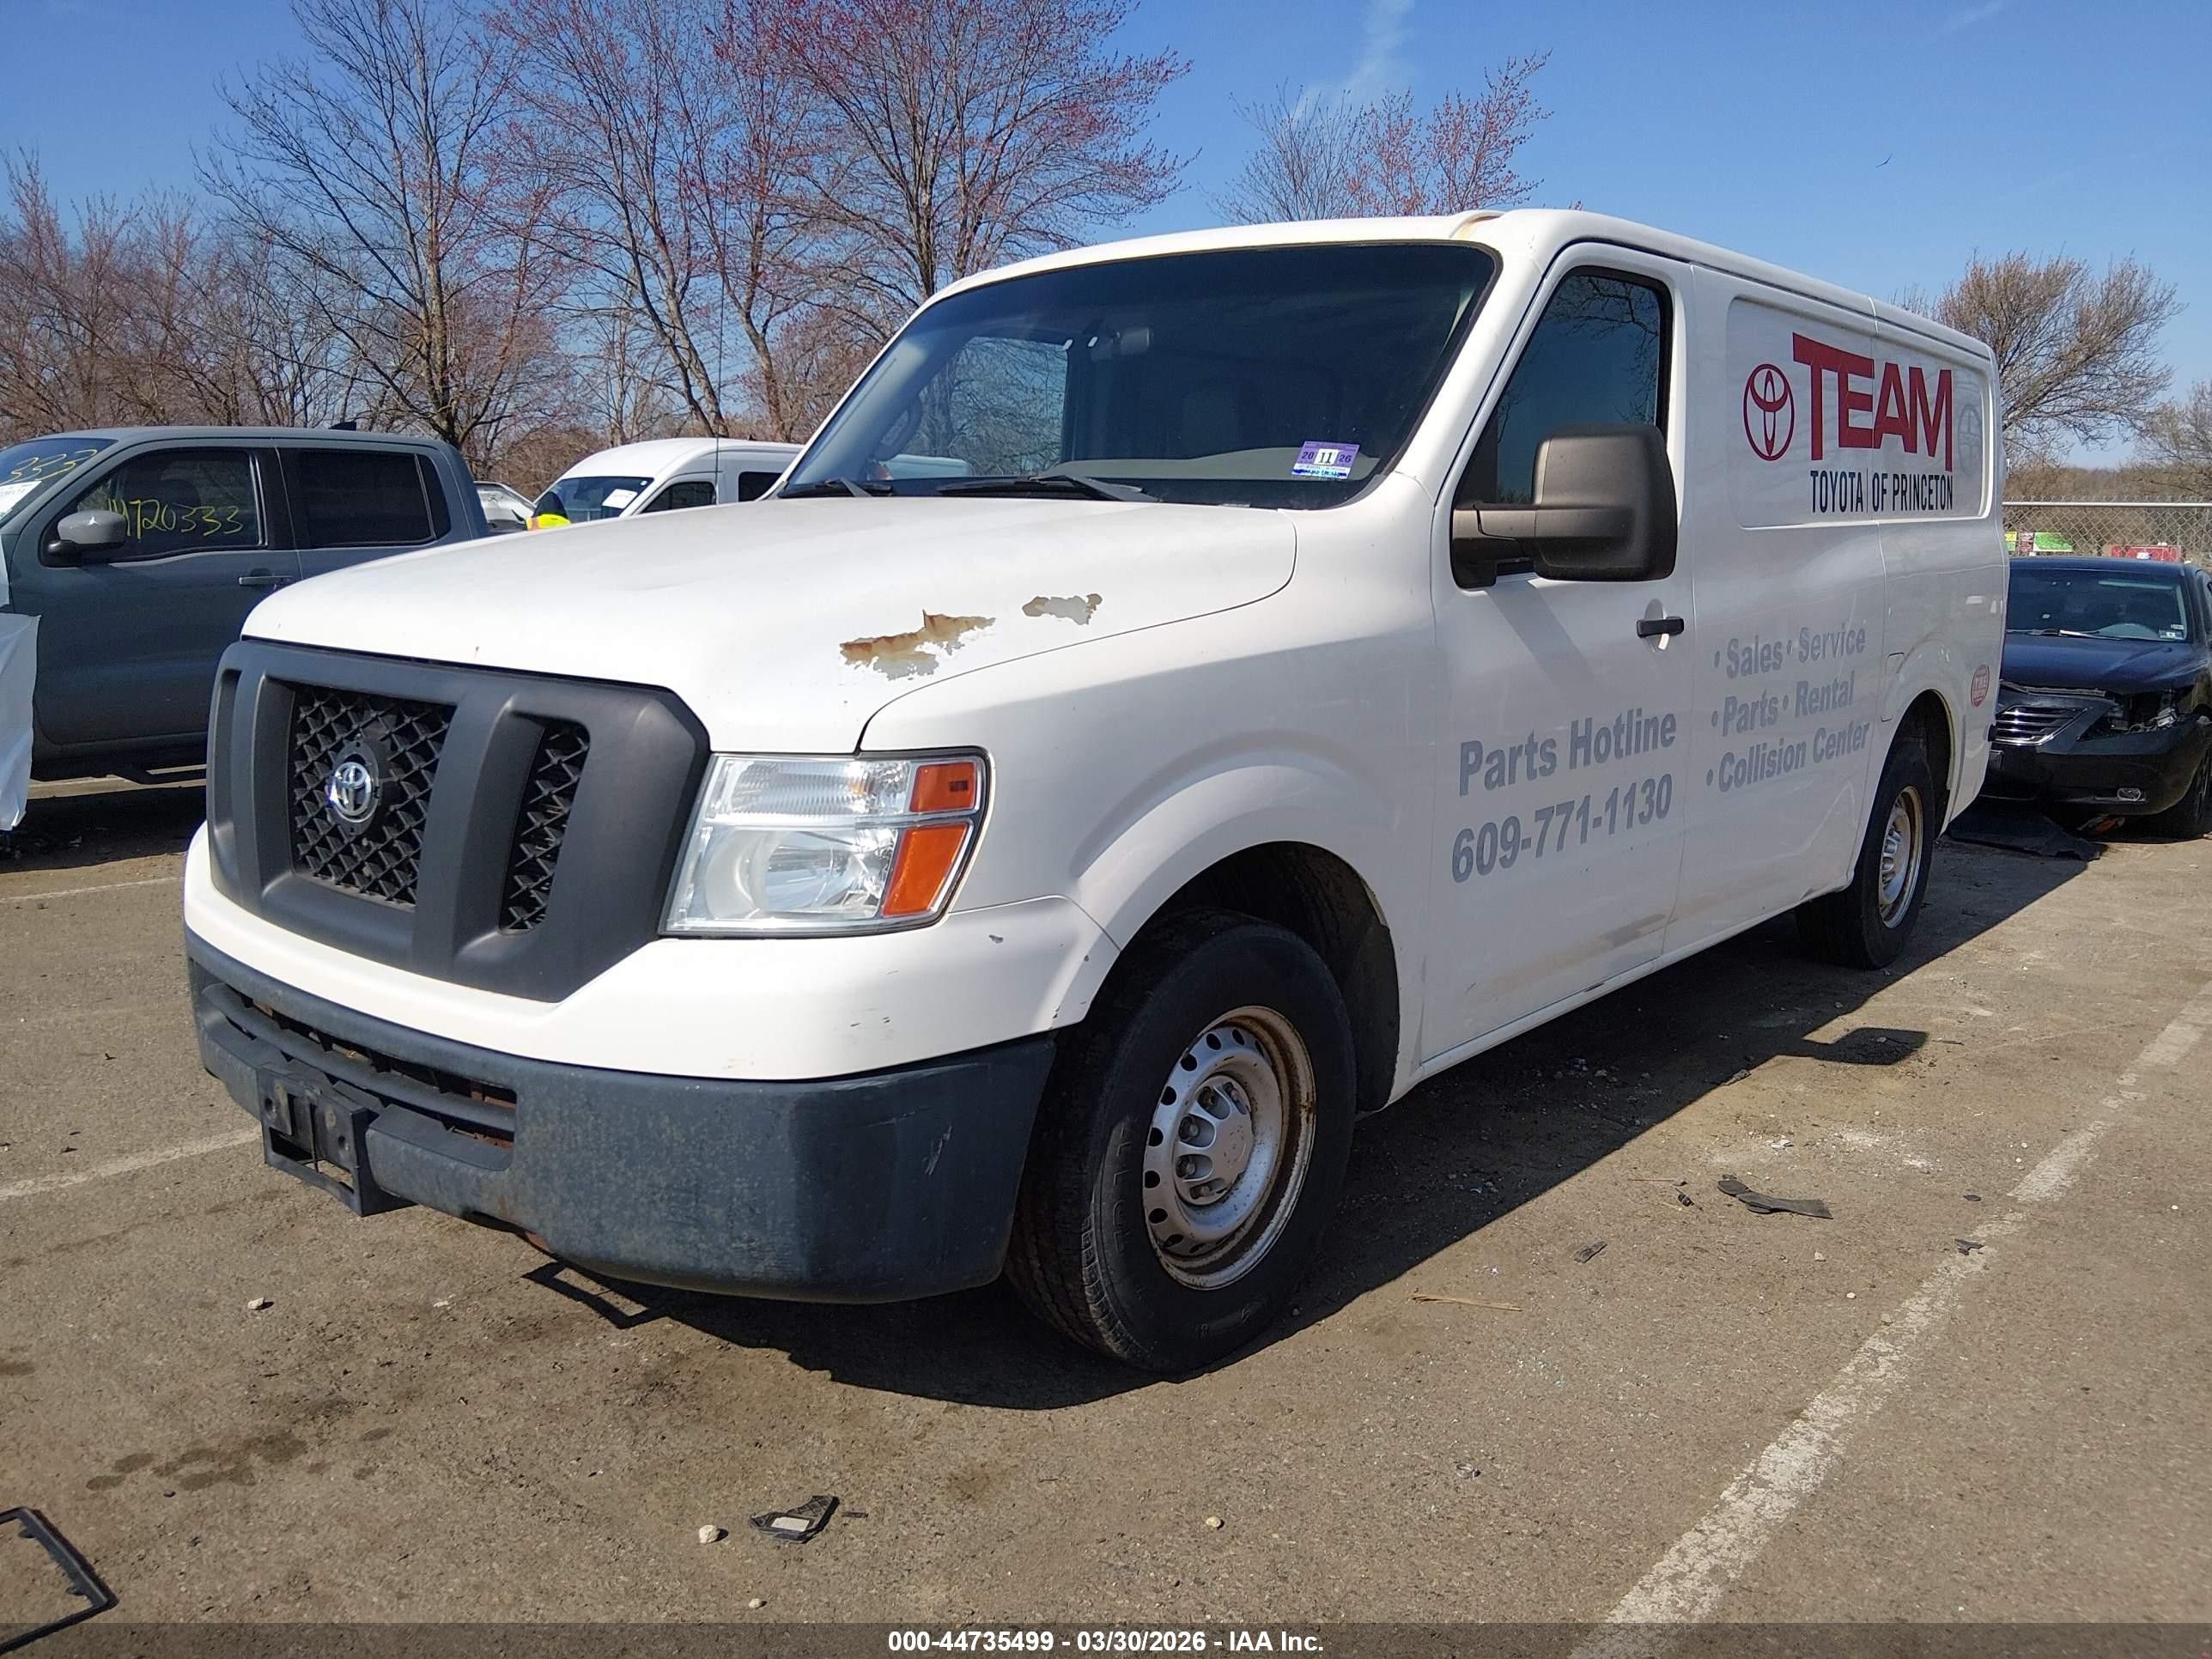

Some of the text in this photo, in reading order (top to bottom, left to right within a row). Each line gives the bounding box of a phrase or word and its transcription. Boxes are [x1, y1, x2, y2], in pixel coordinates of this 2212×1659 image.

[1792, 331, 1953, 472] TEAM
[1301, 451, 1352, 464] 20 11 26
[1810, 470, 1954, 514] TOYOTA OF PRINCETON
[1726, 622, 1865, 679] Sales Service
[1723, 670, 1855, 737] Parts Rental
[1460, 708, 1676, 797] Parts Hotline
[1718, 720, 1870, 793] Collision Center
[1452, 774, 1673, 883] 609-771-1130
